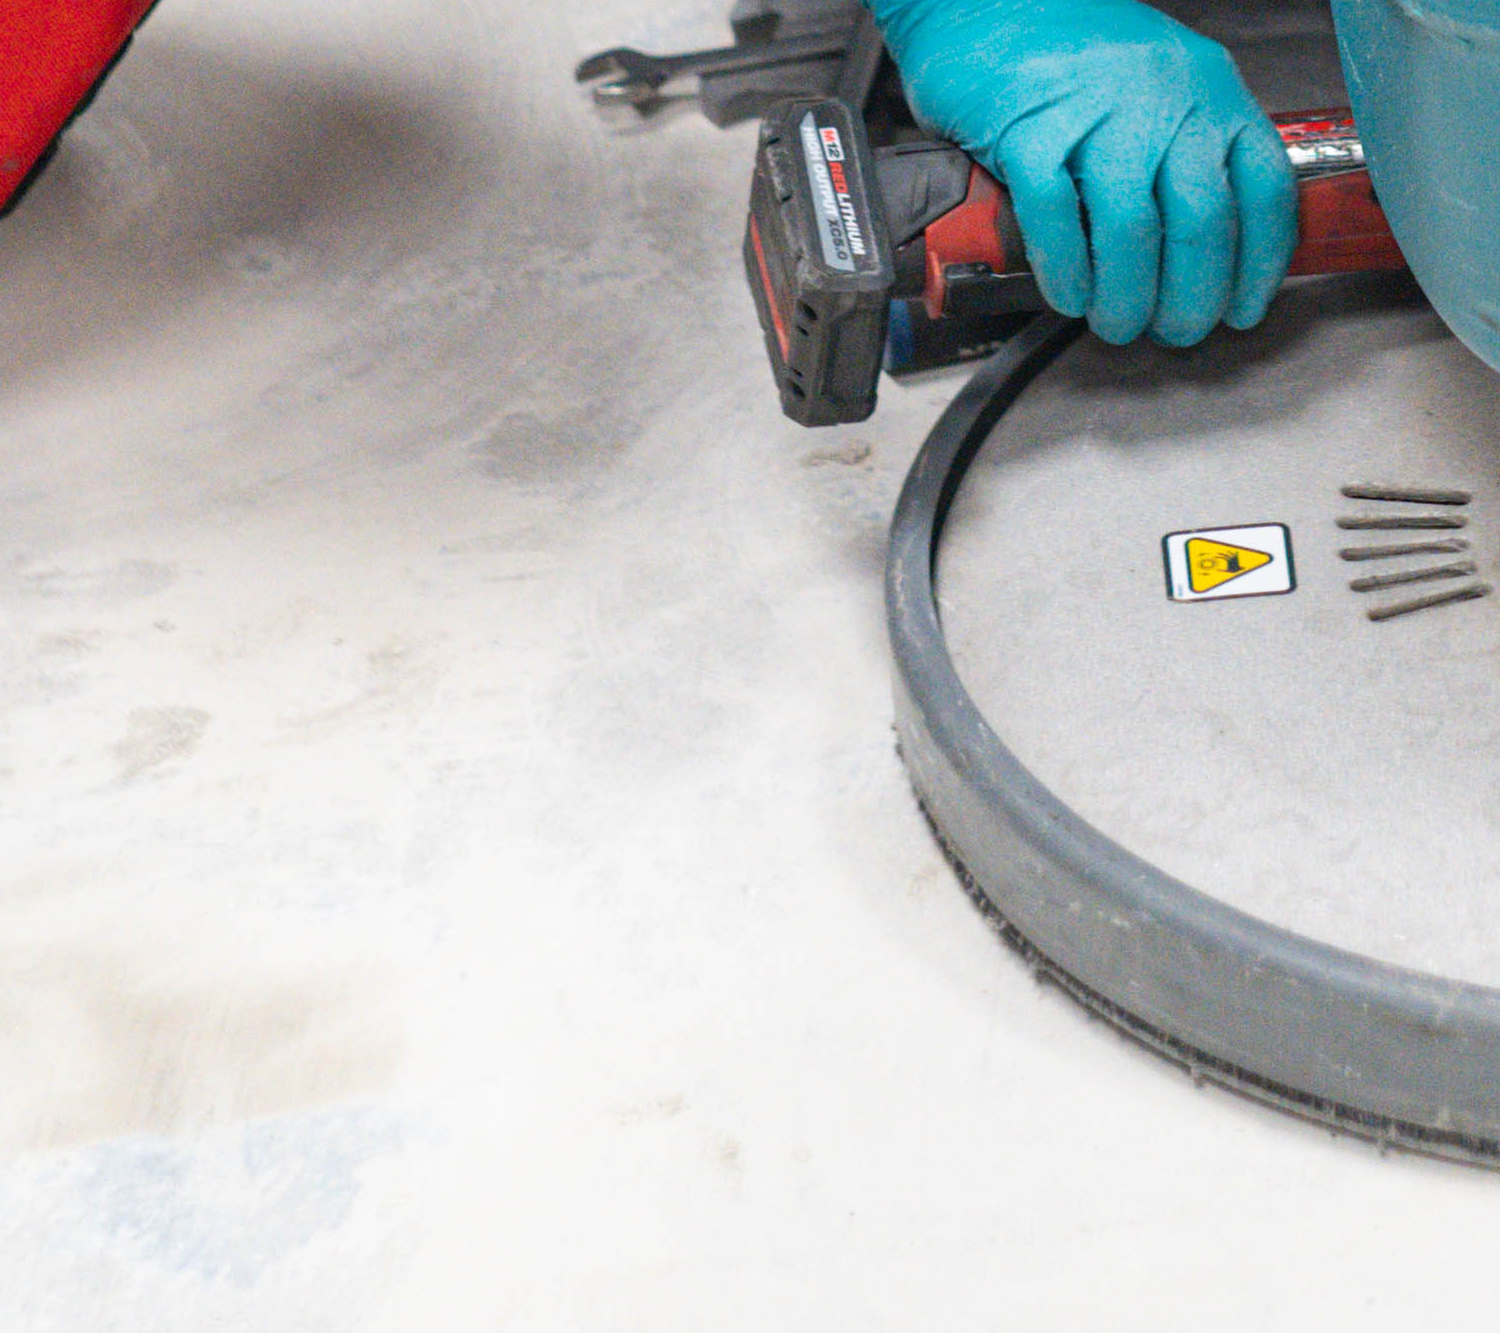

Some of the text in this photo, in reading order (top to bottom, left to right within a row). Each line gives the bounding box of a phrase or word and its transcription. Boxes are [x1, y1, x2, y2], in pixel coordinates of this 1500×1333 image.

[800, 126, 848, 261] HIGH OUTPUT XC5.0
[821, 129, 866, 255] M12 REDLITHIUM
